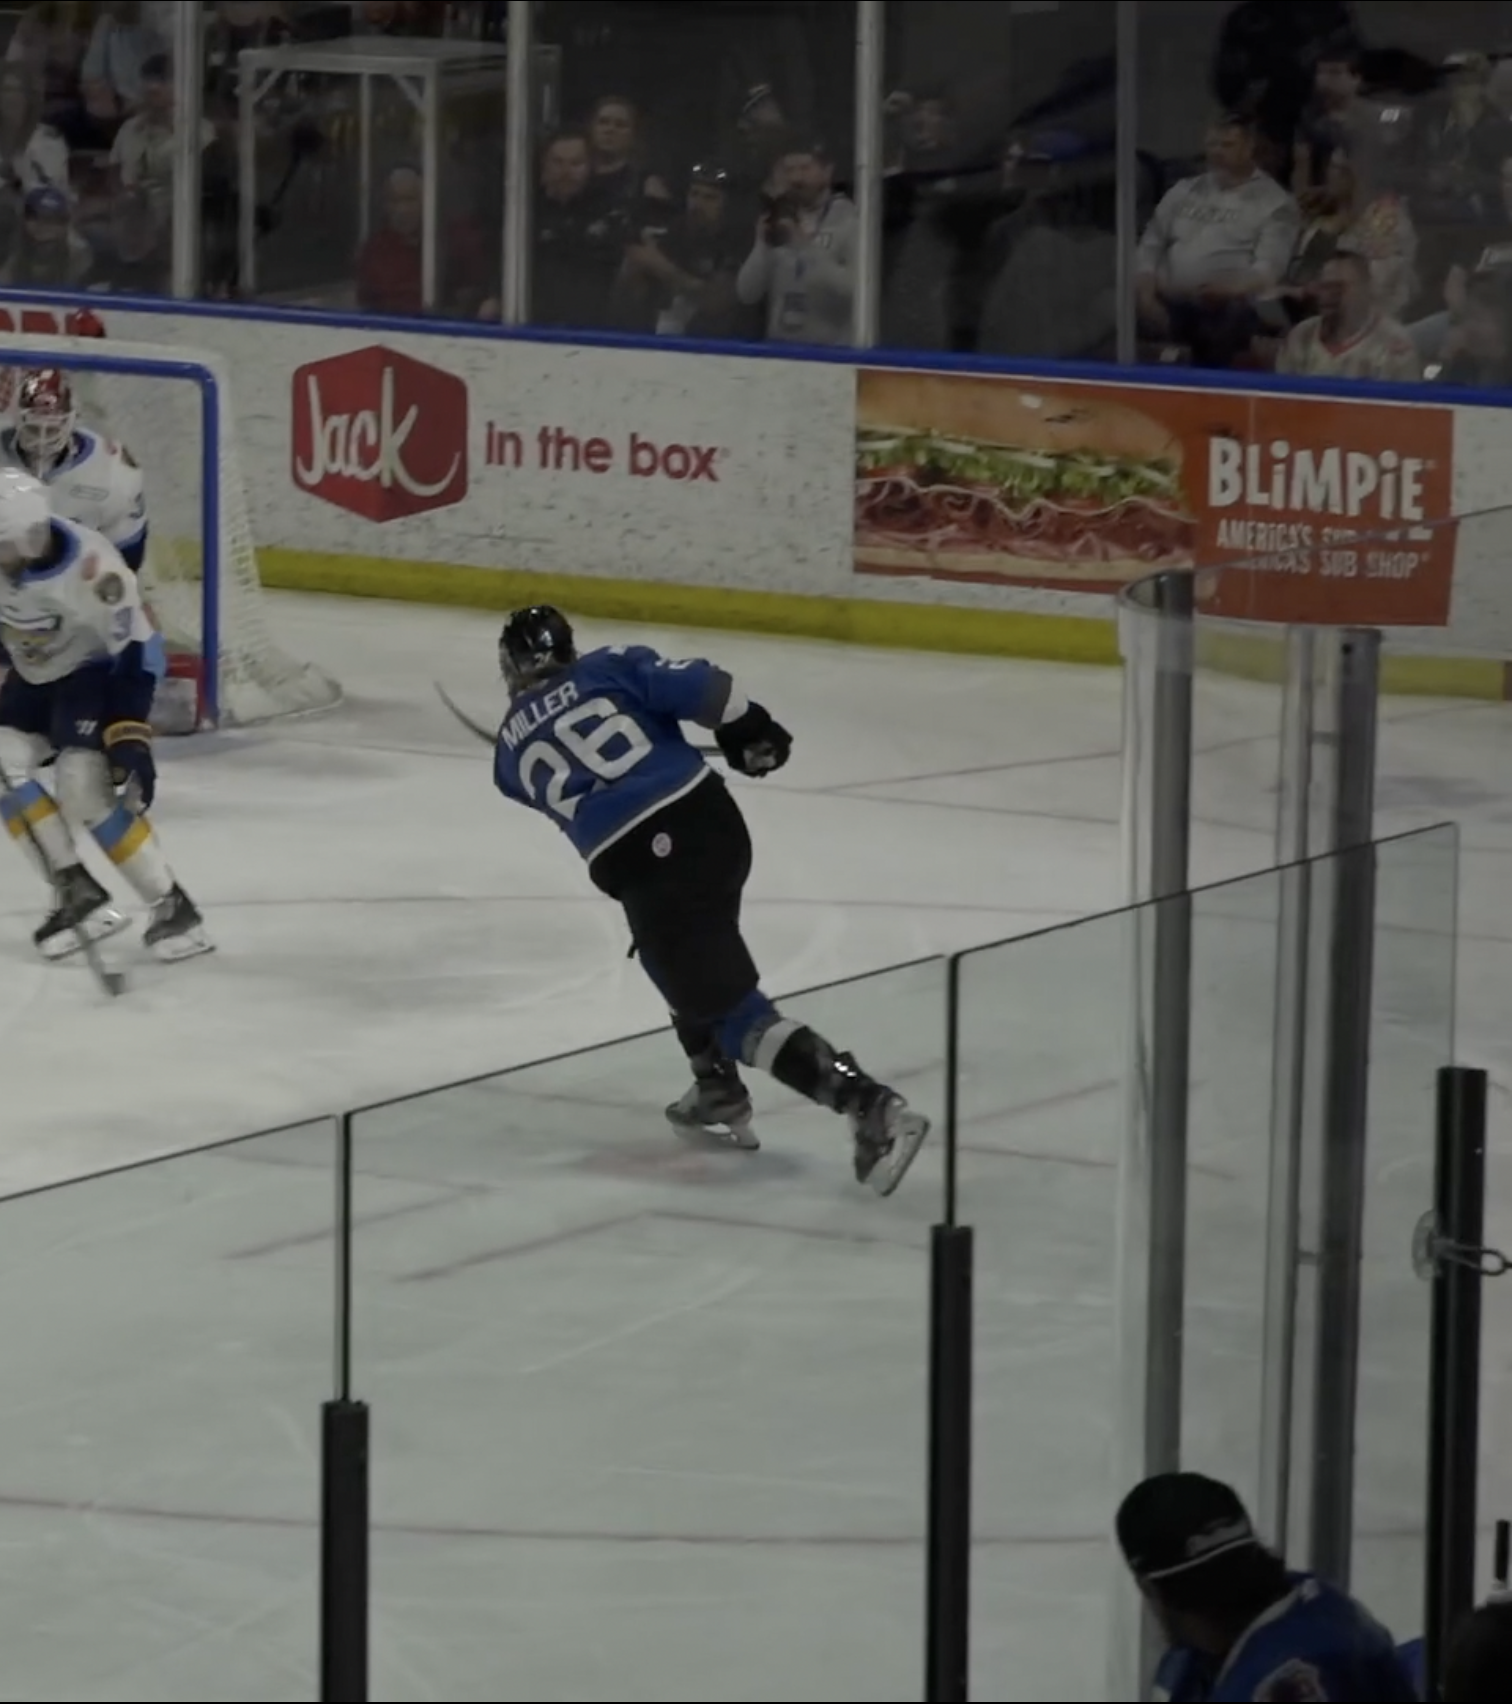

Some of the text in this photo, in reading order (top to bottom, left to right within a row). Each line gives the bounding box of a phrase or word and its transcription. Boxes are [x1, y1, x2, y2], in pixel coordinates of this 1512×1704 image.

[296, 366, 721, 498] Jack in the box
[1366, 550, 1420, 579] SHOP
[501, 680, 580, 752] MILLER
[518, 696, 654, 822] 26
